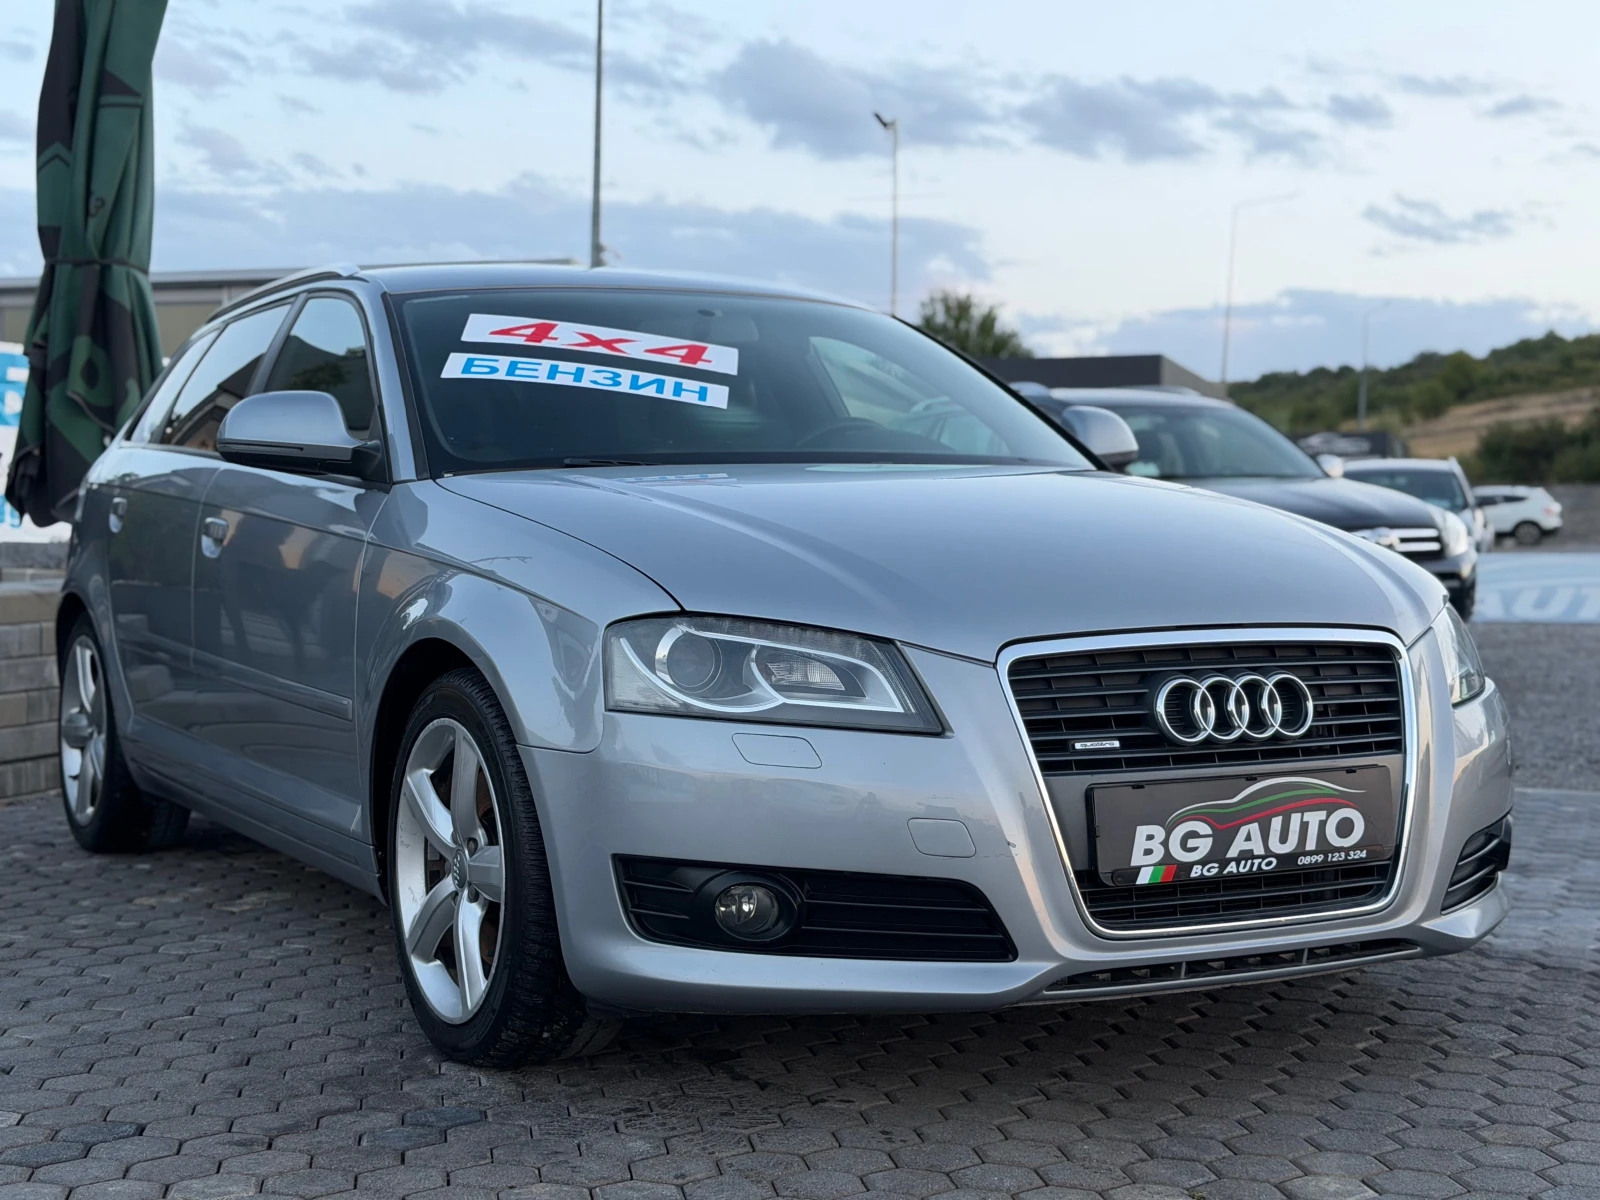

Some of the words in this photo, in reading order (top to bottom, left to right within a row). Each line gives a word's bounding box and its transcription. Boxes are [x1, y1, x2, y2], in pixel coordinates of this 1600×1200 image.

[489, 322, 713, 366] 4x4
[461, 357, 709, 402] БЕНЗИН
[1130, 820, 1213, 867] BG
[1226, 807, 1365, 858] AUTO
[1297, 854, 1325, 866] 0899
[1327, 851, 1346, 862] 123
[1347, 849, 1368, 860] 324
[1190, 863, 1220, 878] BG
[1223, 857, 1278, 875] AUTO
